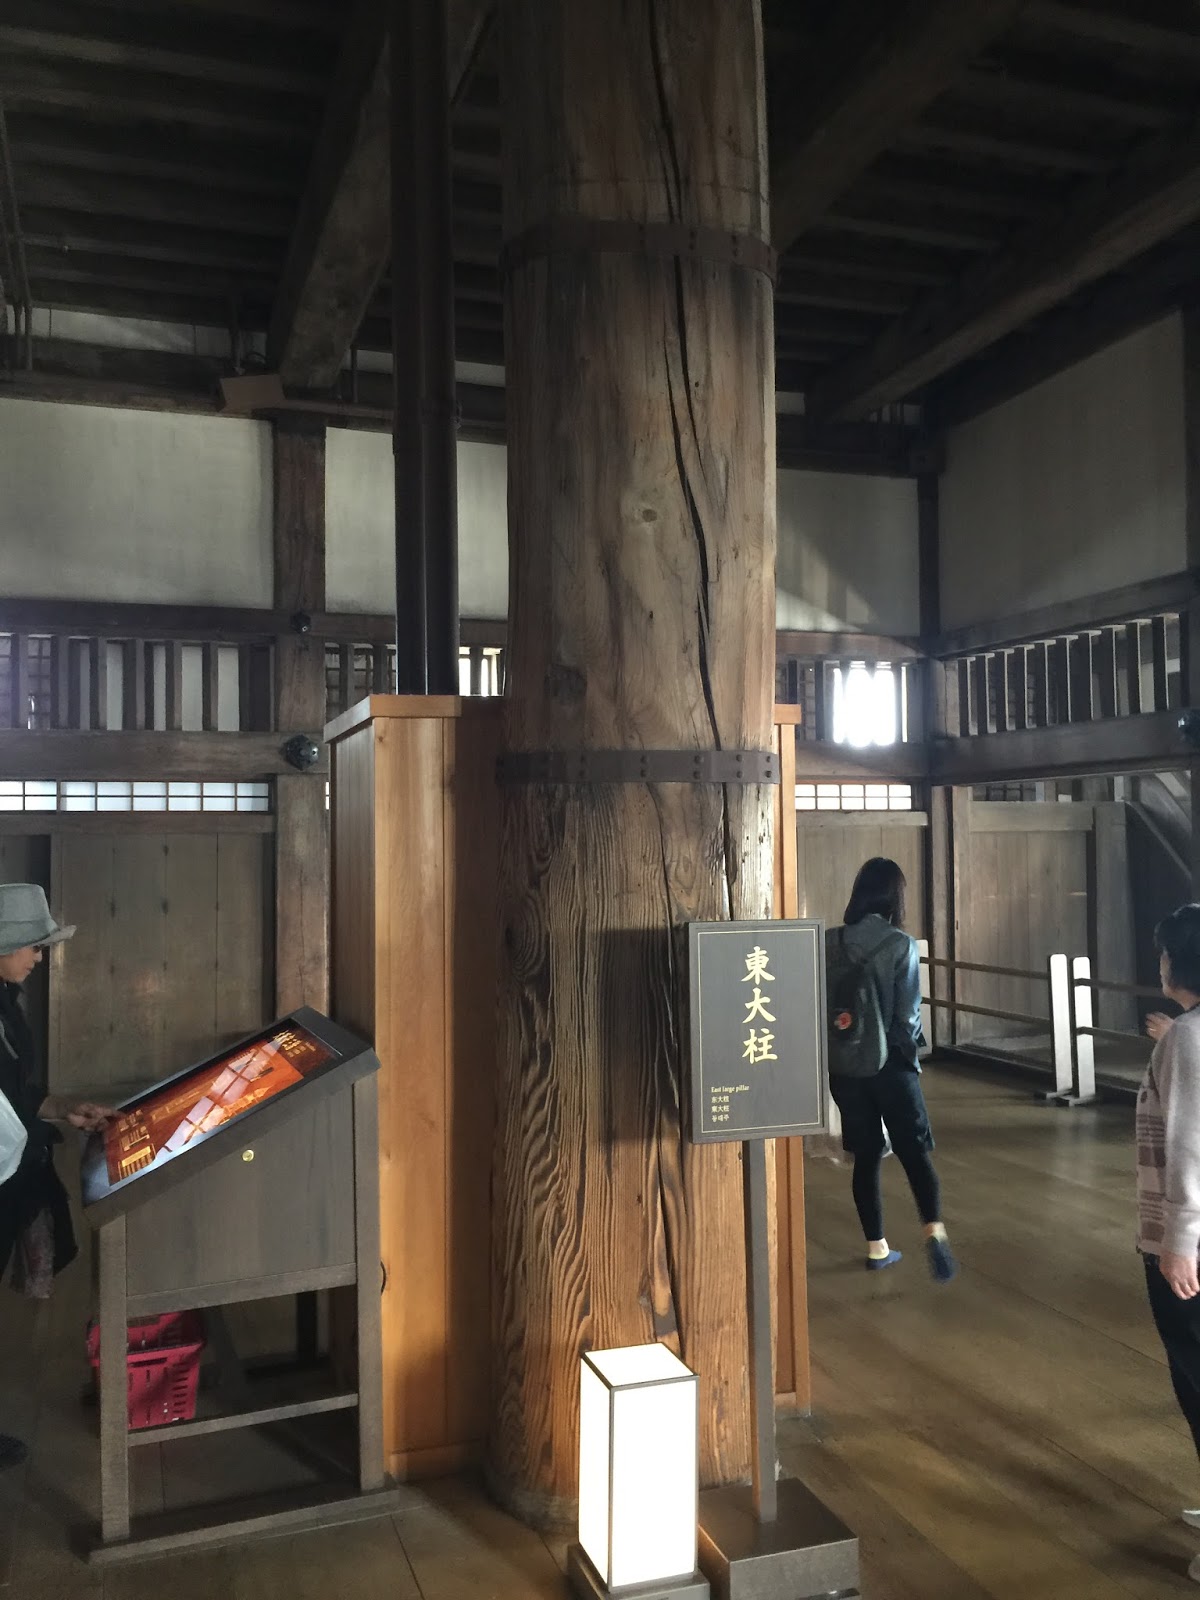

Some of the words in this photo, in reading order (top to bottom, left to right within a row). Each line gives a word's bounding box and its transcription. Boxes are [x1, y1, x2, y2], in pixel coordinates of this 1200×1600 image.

[741, 945, 779, 1065] 東大柱
[722, 1085, 735, 1093] large
[736, 1084, 750, 1092] pillar
